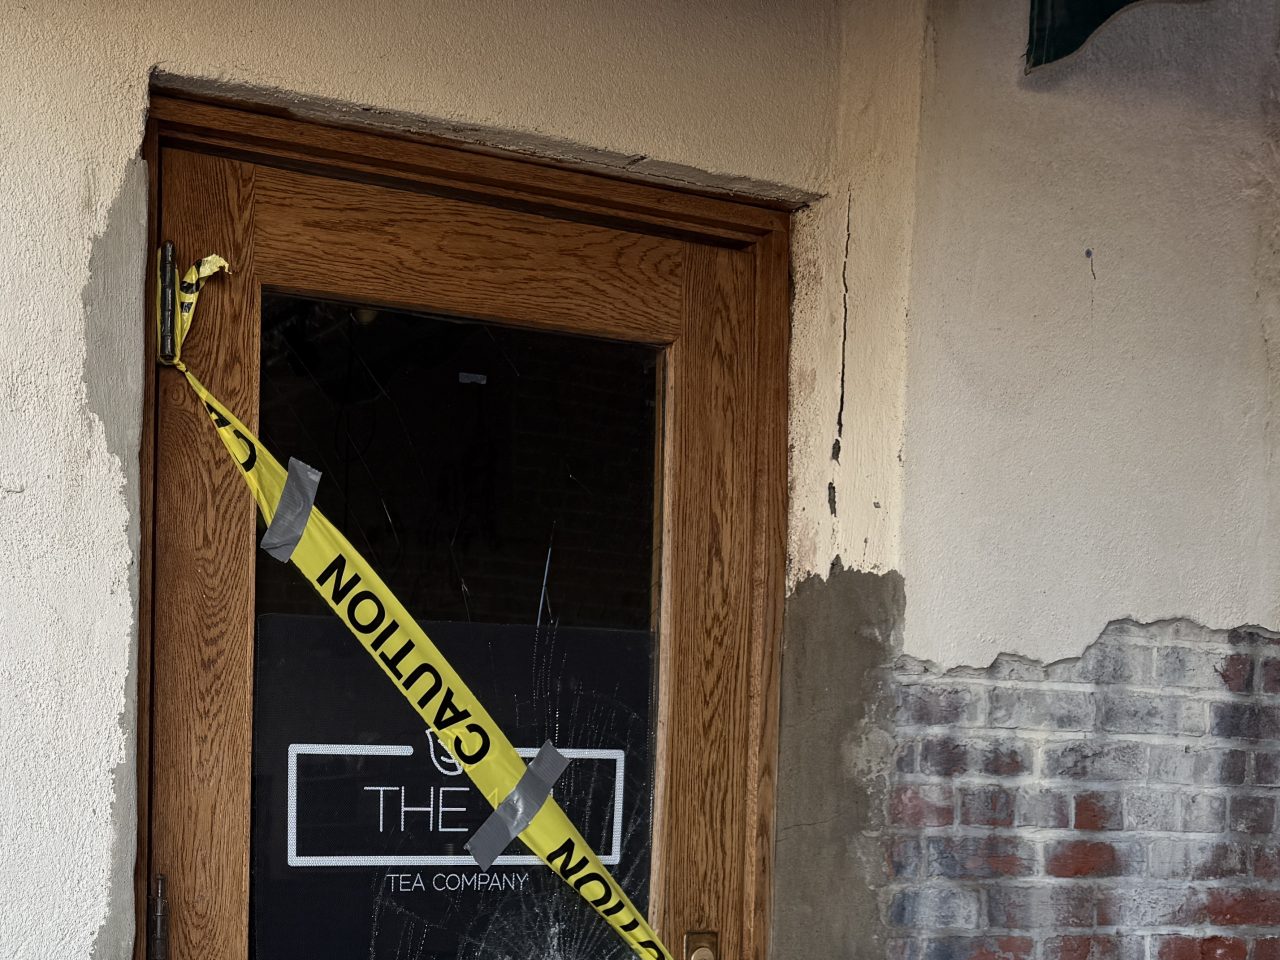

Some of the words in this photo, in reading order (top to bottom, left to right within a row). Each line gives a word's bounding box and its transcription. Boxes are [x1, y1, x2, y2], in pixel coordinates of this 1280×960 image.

[316, 553, 490, 765] CAUTION
[363, 785, 470, 832] THE
[386, 873, 425, 892] TEA
[432, 873, 529, 891] COMPANY
